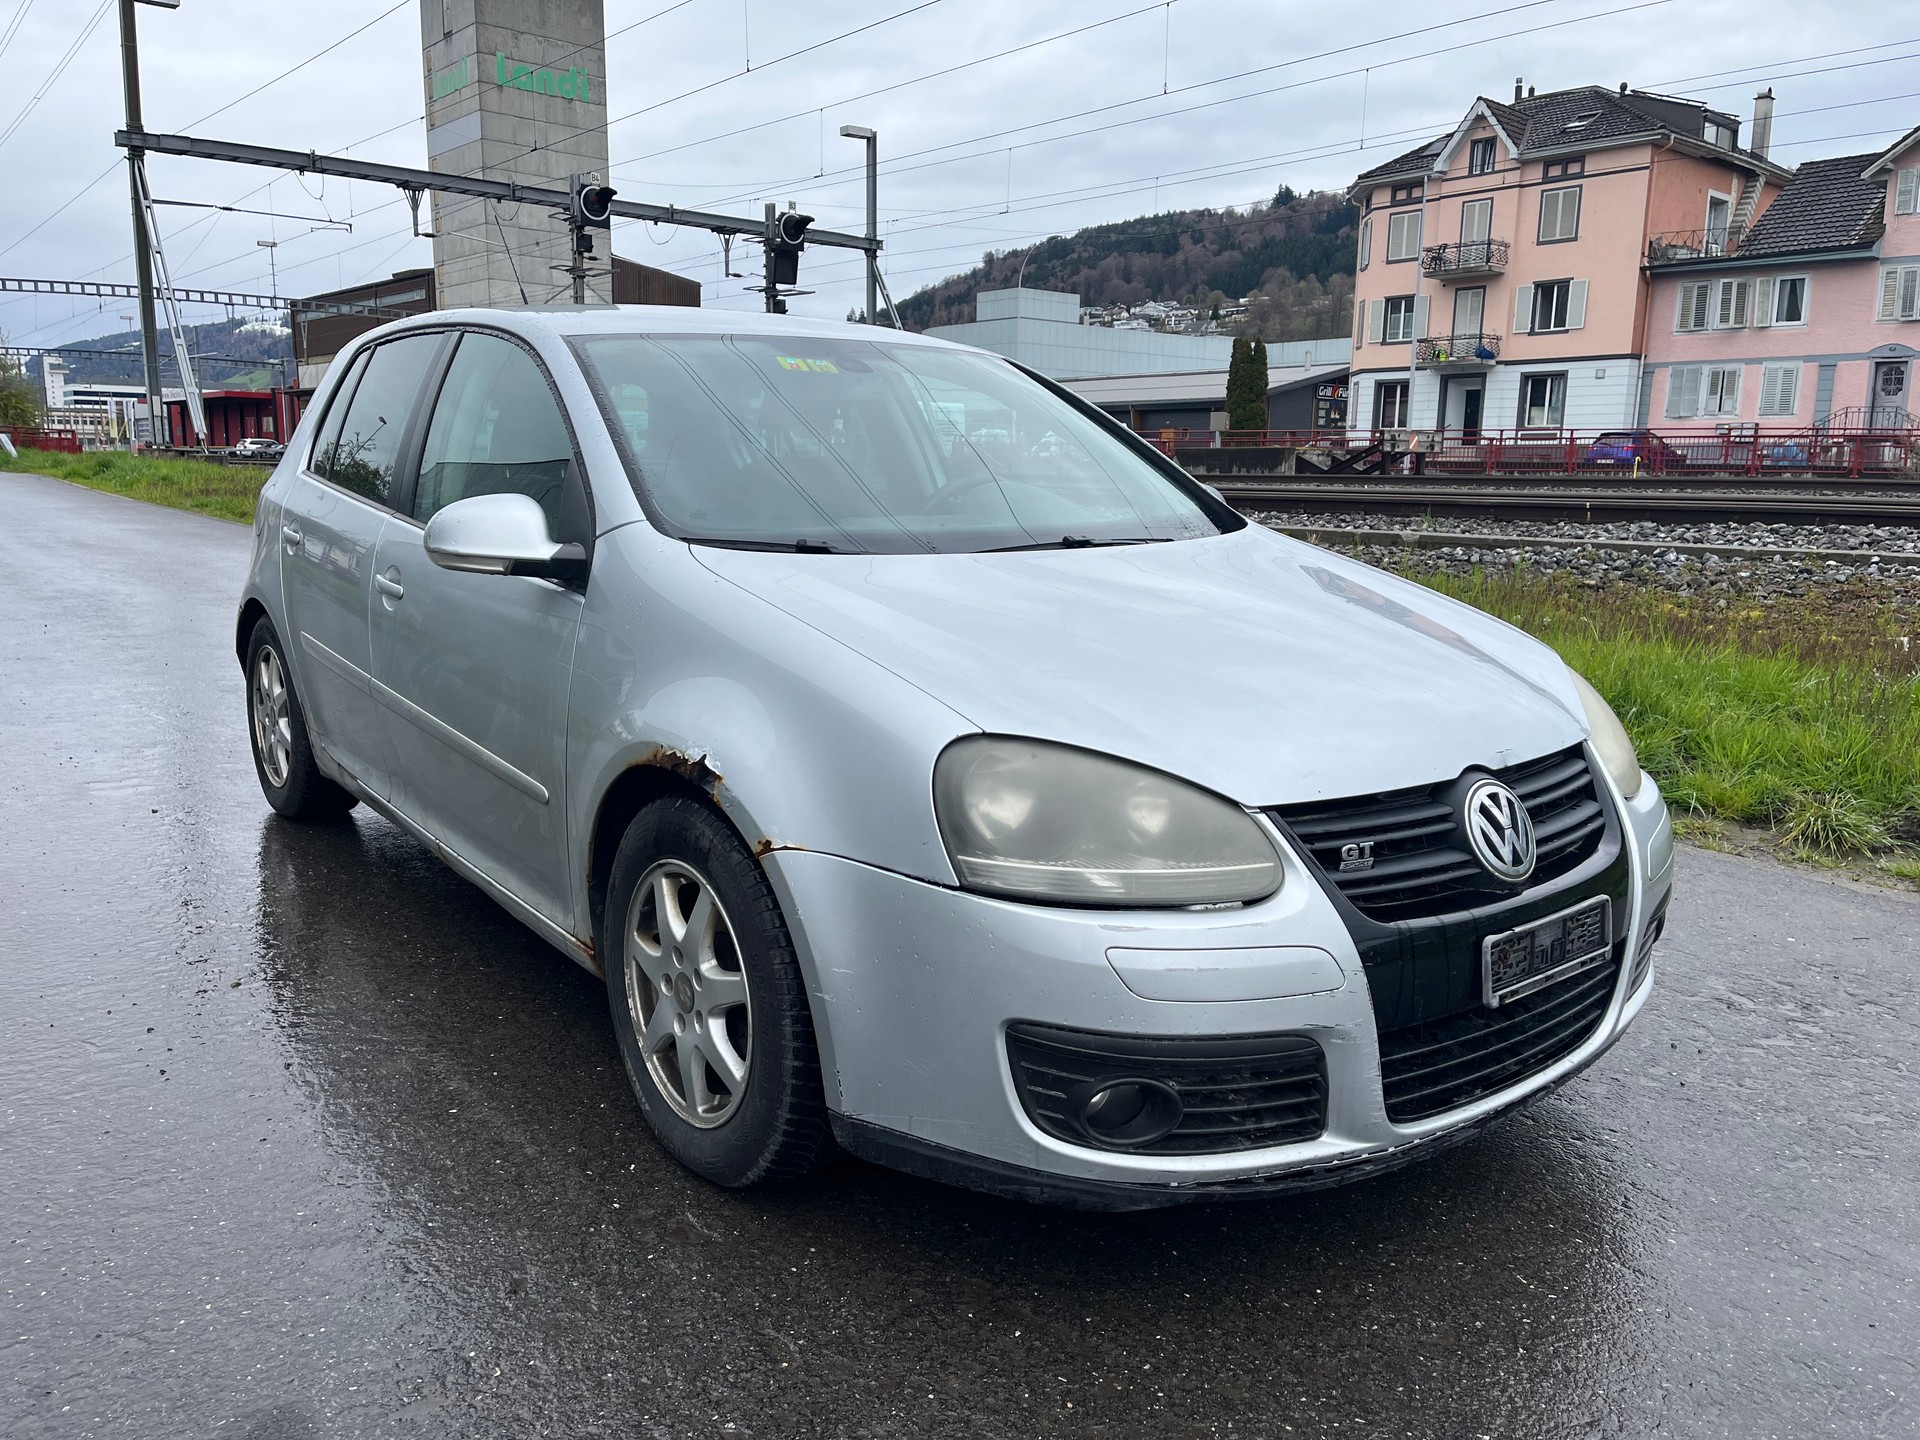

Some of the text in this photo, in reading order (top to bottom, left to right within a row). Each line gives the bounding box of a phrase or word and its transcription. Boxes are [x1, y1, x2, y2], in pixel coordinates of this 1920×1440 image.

[591, 173, 599, 182] B4
[1319, 386, 1333, 397] Grill
[1341, 841, 1375, 861] GT
